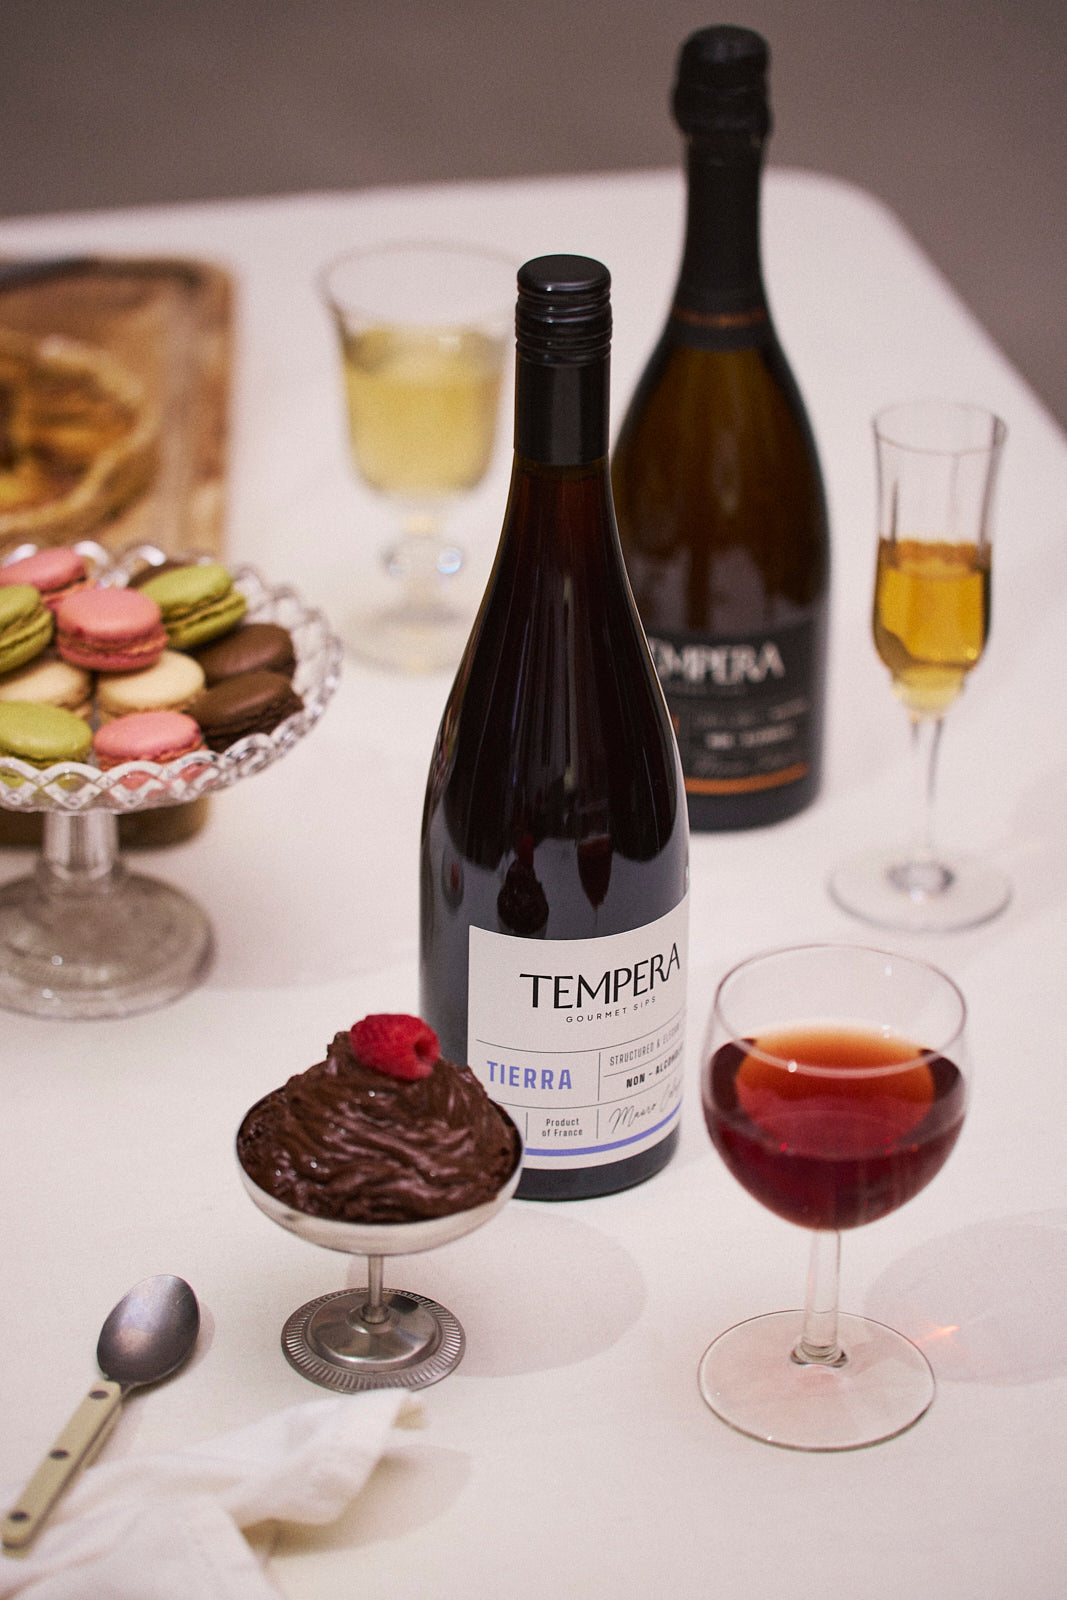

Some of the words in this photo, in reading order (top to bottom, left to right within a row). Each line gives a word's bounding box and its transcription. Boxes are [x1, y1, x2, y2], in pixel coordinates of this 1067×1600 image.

[519, 942, 681, 1009] TEMPERA
[566, 1007, 628, 1023] GOURMET
[633, 996, 657, 1011] SIPS
[609, 1041, 654, 1067] STRUCTURED
[486, 1060, 572, 1090] TIERRA
[626, 1072, 646, 1089] NON
[541, 1129, 551, 1137] of
[554, 1129, 583, 1137] France
[546, 1118, 580, 1127] Product
